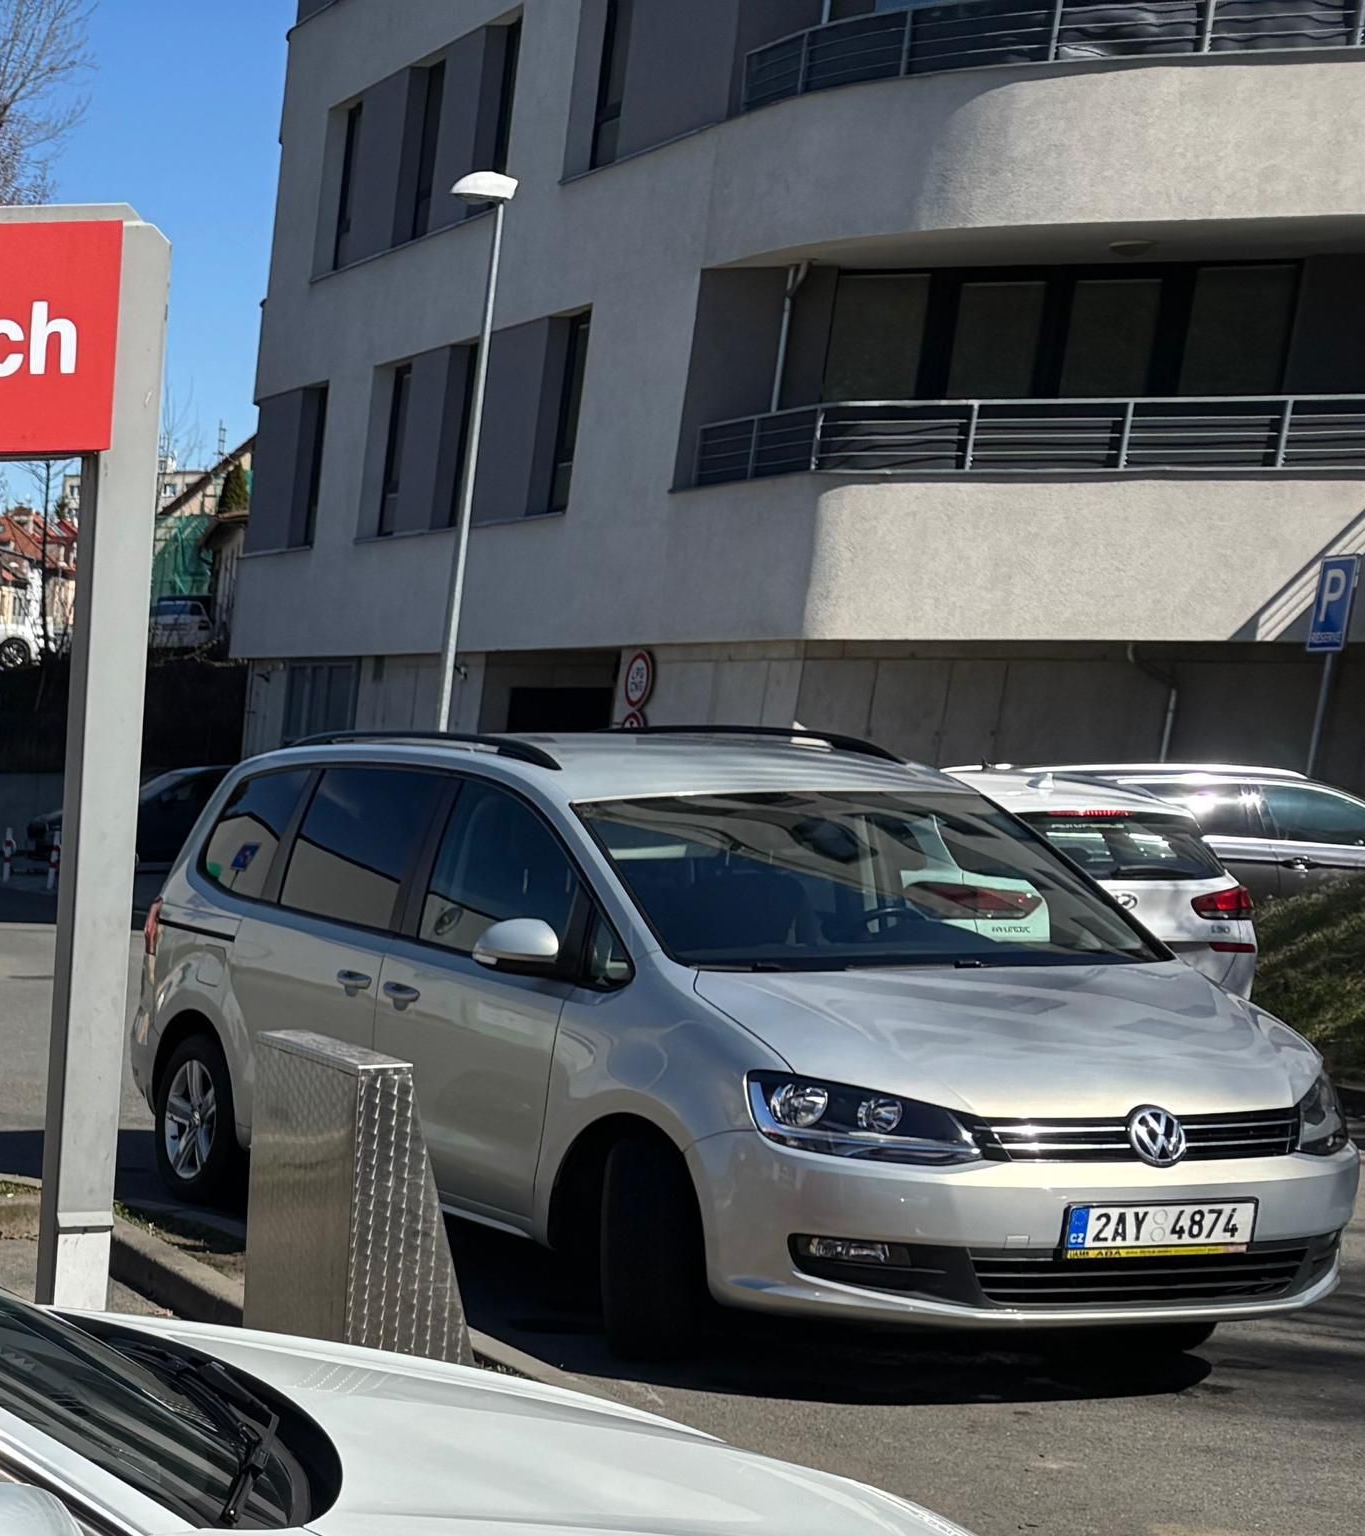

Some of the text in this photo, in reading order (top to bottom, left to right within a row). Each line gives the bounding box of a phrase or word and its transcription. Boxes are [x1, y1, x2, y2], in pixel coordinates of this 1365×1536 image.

[1319, 568, 1346, 622] P
[1070, 1232, 1085, 1243] CZ
[1092, 1208, 1239, 1243] 2AY 4874
